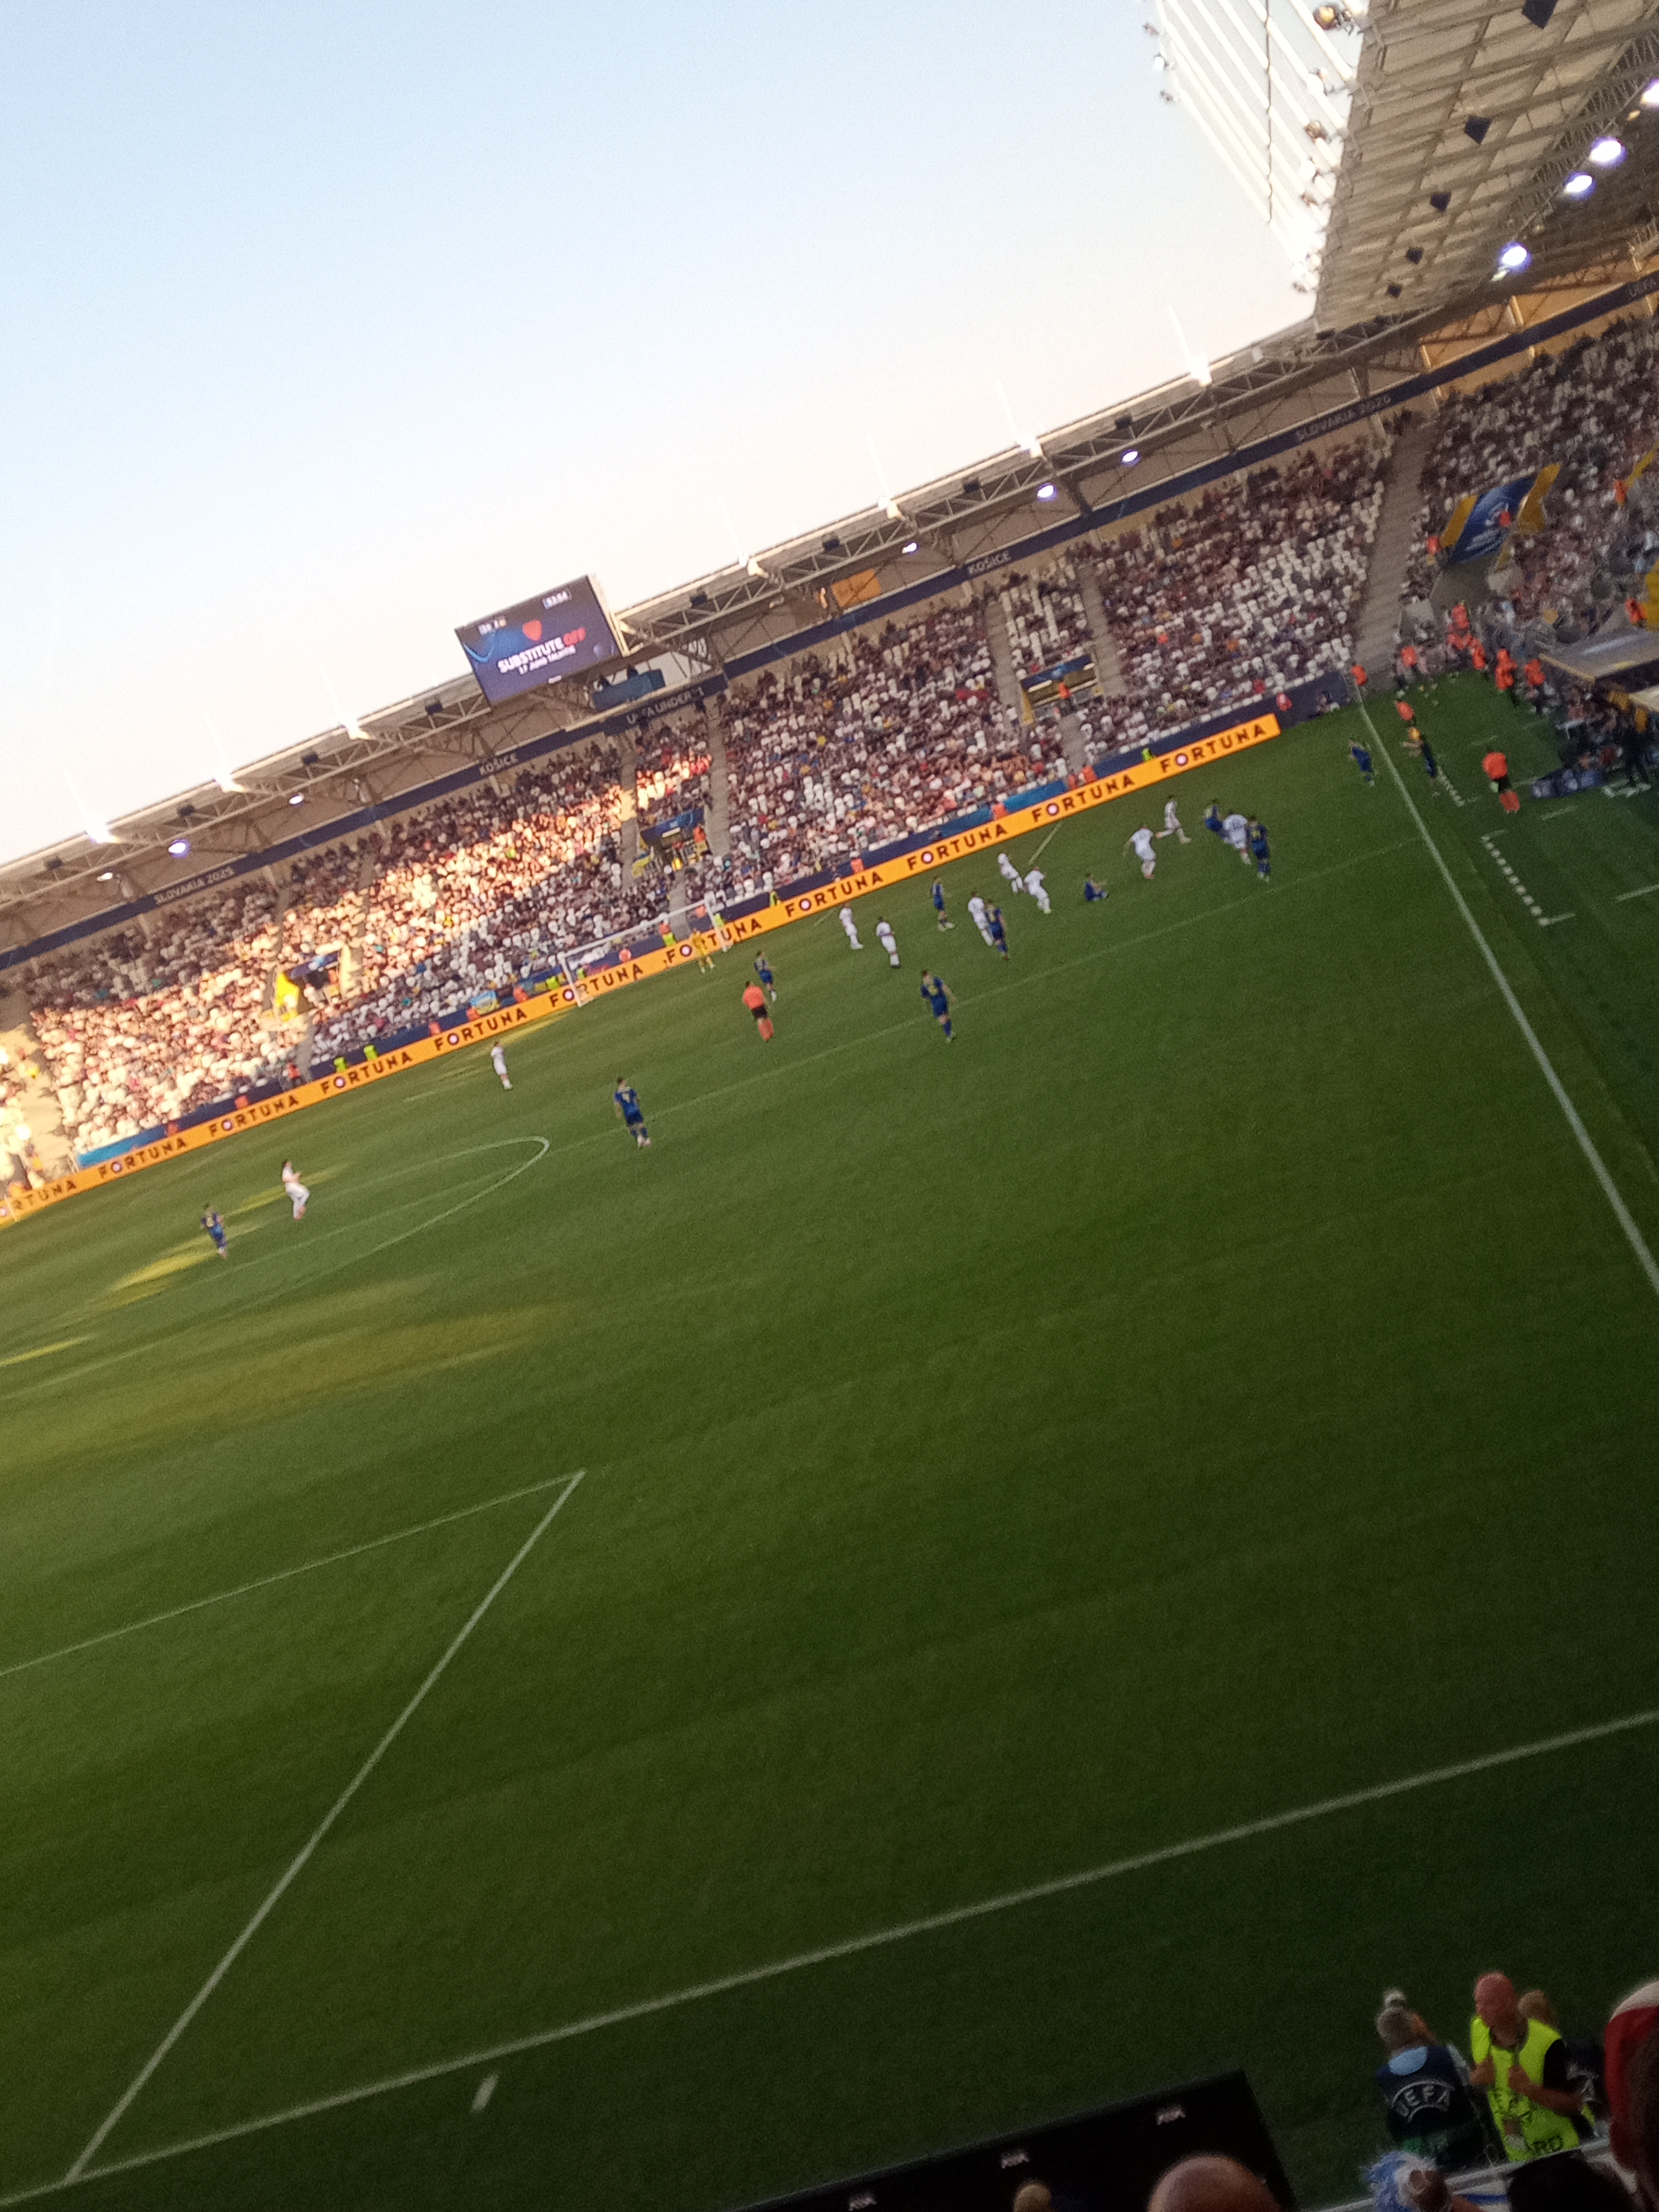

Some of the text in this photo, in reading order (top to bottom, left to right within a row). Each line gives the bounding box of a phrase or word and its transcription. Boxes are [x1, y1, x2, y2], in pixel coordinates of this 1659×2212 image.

[498, 627, 587, 673] SUBSTITUTE OFF
[1160, 723, 1267, 773] FORTUNA
[1032, 774, 1135, 822] FORTUNA
[907, 823, 1008, 870] FORTUNA
[154, 878, 204, 903] SLOVAKIA
[786, 871, 883, 916] FORTUNA
[434, 1008, 527, 1051] FORTUNA
[320, 1051, 412, 1094] FORTUNA
[209, 1094, 299, 1137] FORTUNA
[97, 1137, 187, 1179] FORTUNA
[1395, 2085, 1451, 2117] UEFA
